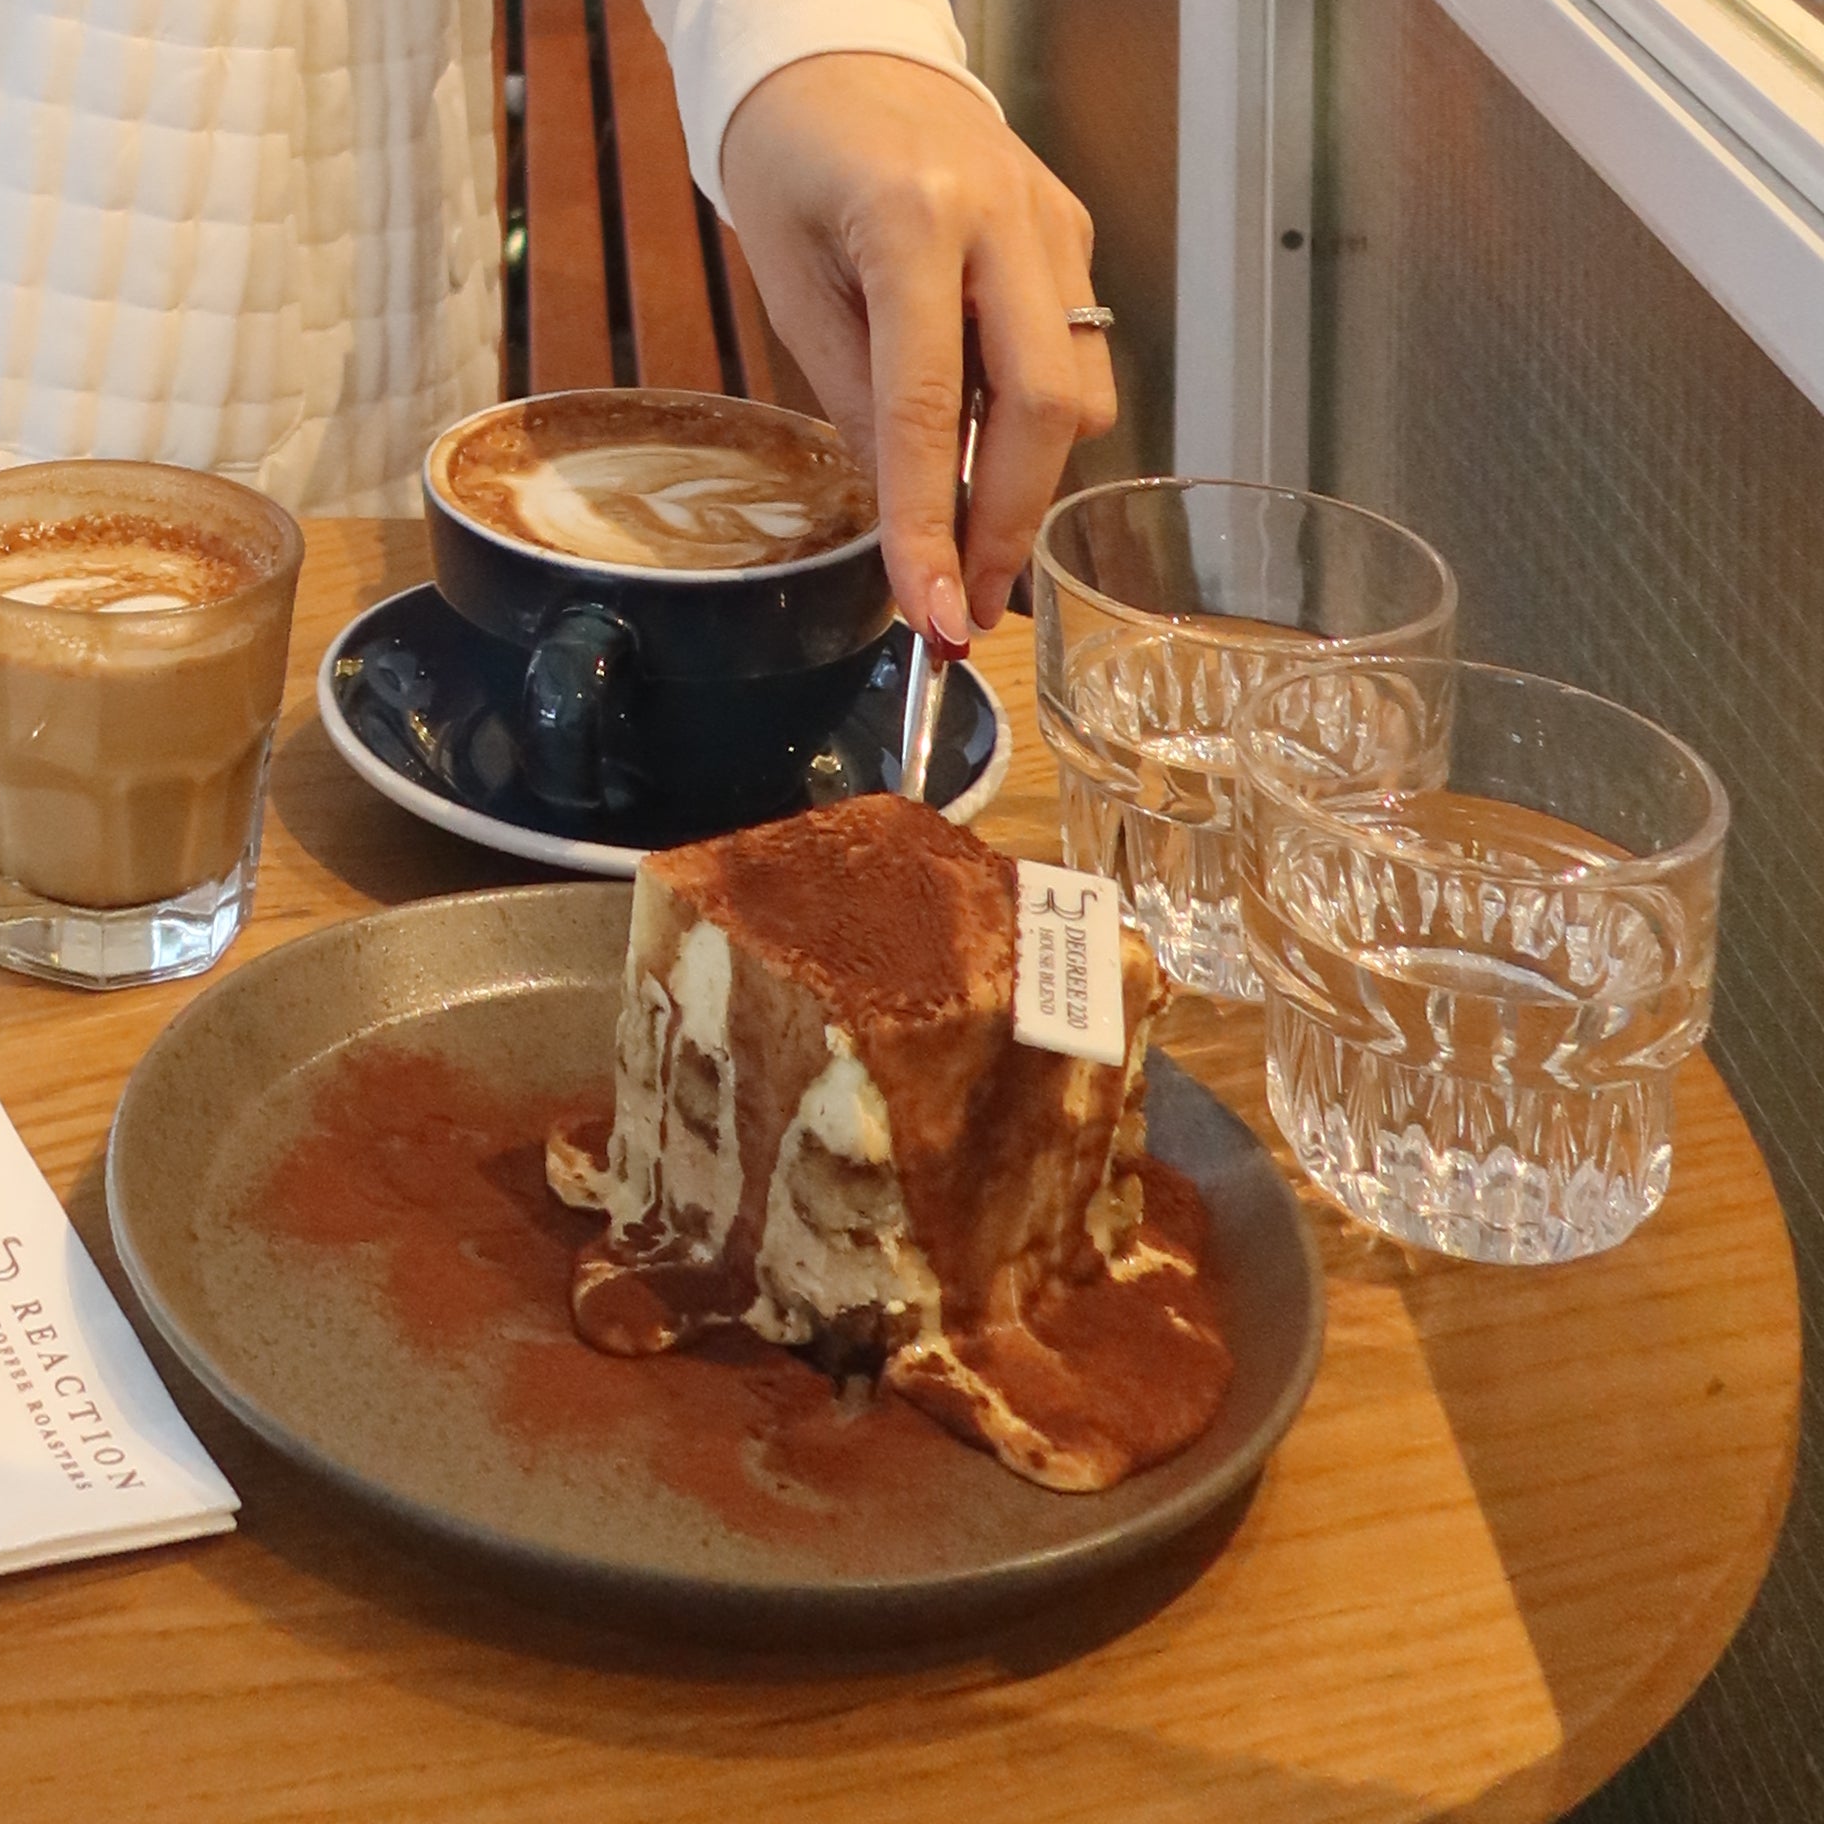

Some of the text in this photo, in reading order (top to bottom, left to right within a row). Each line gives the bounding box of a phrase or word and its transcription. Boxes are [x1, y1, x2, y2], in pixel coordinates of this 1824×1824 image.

[1039, 926, 1057, 1016] HOUSE BLEND
[1065, 925, 1089, 1030] DEGREE 220
[11, 1298, 146, 1494] REACTION
[27, 1400, 93, 1492] ROASTERS
